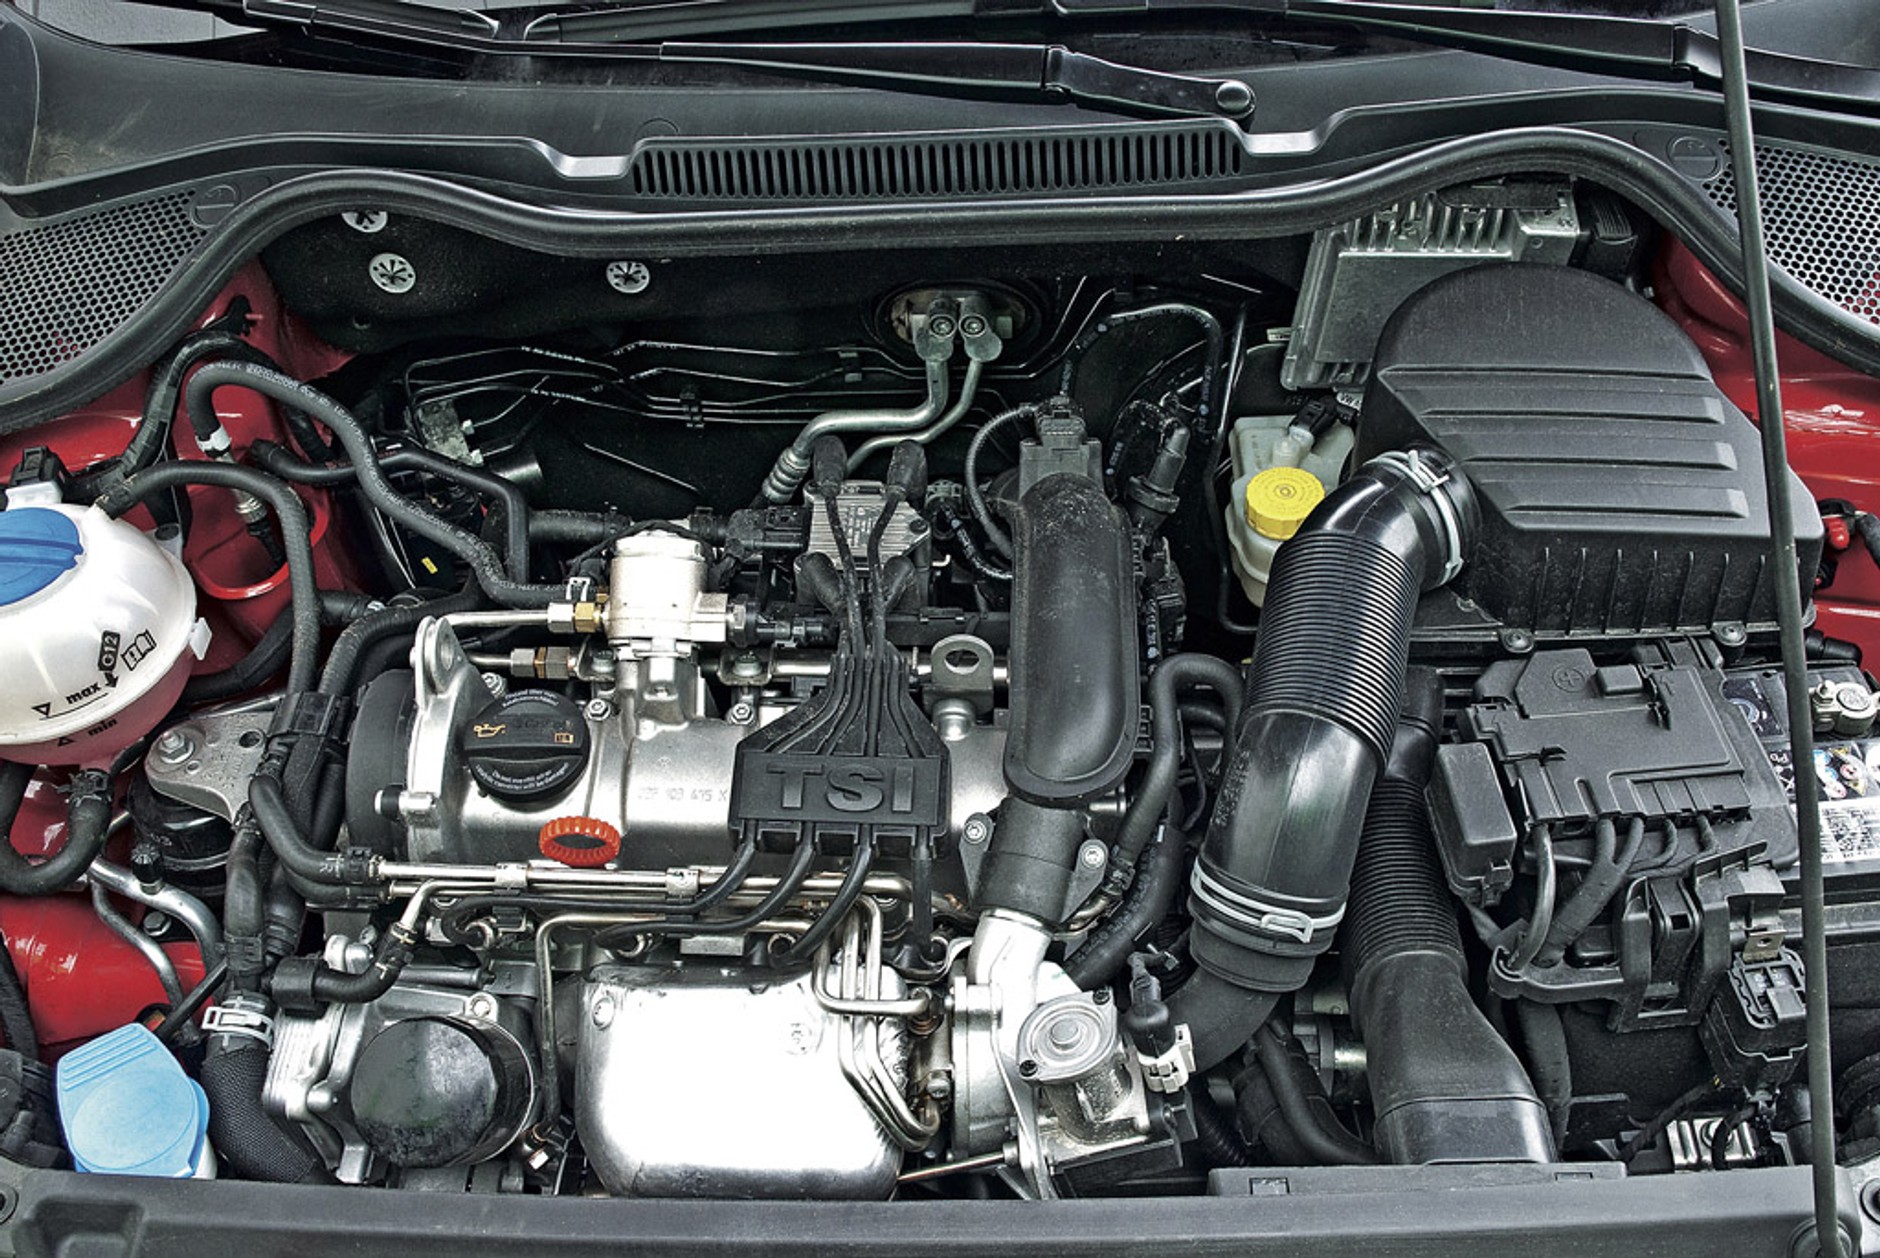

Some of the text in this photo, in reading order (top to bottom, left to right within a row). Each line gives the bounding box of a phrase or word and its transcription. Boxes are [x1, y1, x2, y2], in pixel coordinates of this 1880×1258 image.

[66, 682, 101, 705] max
[88, 718, 117, 736] min
[767, 763, 915, 813] TSI
